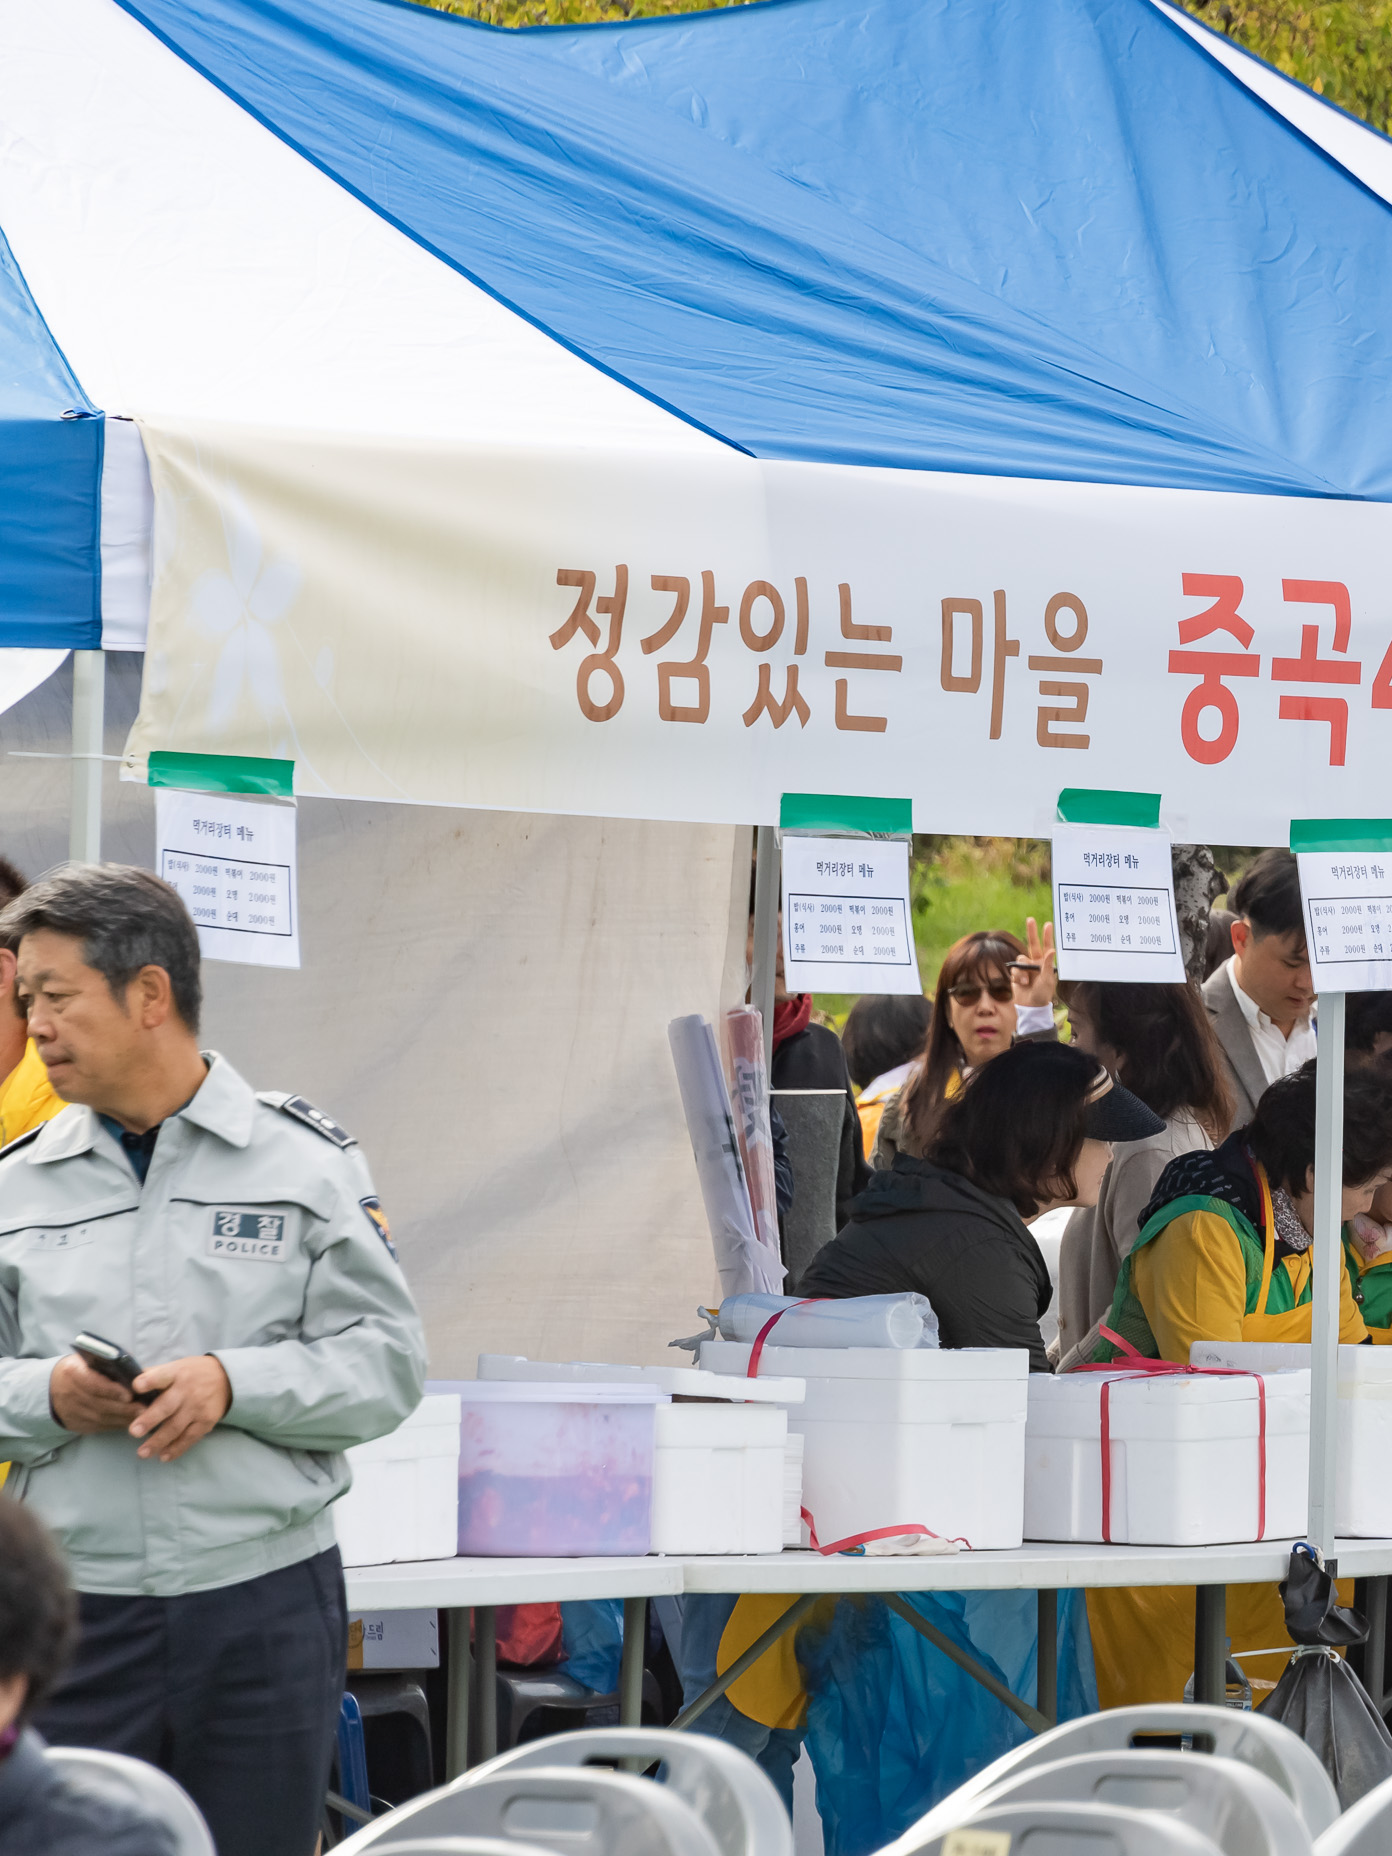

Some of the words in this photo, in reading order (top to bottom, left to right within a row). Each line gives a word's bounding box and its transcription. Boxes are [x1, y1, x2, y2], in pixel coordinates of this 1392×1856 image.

[547, 563, 903, 733] 정감있는
[940, 588, 1103, 750] 마을
[192, 819, 232, 840] 먹거리장터
[236, 825, 255, 843] 메뉴
[1083, 852, 1121, 868] 먹거리장터
[1124, 854, 1140, 869] 메뉴
[194, 863, 219, 876] 2000원
[249, 871, 276, 883] 2000원
[816, 861, 854, 878] 먹거리장터
[858, 864, 874, 879] 메뉴
[1331, 865, 1368, 880] 먹거리장터
[1371, 865, 1385, 879] 메뉴
[192, 884, 217, 898] 2000원
[248, 892, 276, 904] 2000원
[1063, 892, 1084, 903] 밥(식사)
[1089, 893, 1111, 904] 2000원
[1137, 895, 1159, 906] 2000원
[192, 906, 217, 920] 2000원
[248, 914, 276, 927] 2000원
[793, 902, 815, 913] 밥(식사)
[820, 903, 843, 914] 2000원
[871, 905, 894, 917] 2000원
[1314, 906, 1336, 916] 밥(식사)
[1341, 904, 1363, 915] 2000원
[1088, 913, 1111, 923] 2000원
[1138, 915, 1161, 926] 2000원
[819, 923, 842, 934] 2000원
[871, 925, 895, 937] 2000원
[1342, 925, 1363, 935] 2000원
[1065, 932, 1077, 943] 주류
[1090, 933, 1112, 944] 2000원
[1120, 934, 1131, 945] 순대
[1139, 935, 1162, 946] 2000원
[794, 943, 806, 954] 주류
[821, 944, 844, 955] 2000원
[853, 945, 865, 956] 순대
[873, 945, 897, 957] 2000원
[1319, 945, 1330, 956] 주류
[1344, 944, 1366, 954] 2000원
[1373, 943, 1383, 954] 순대
[216, 1211, 283, 1241] 경찰
[213, 1239, 281, 1256] POLICE
